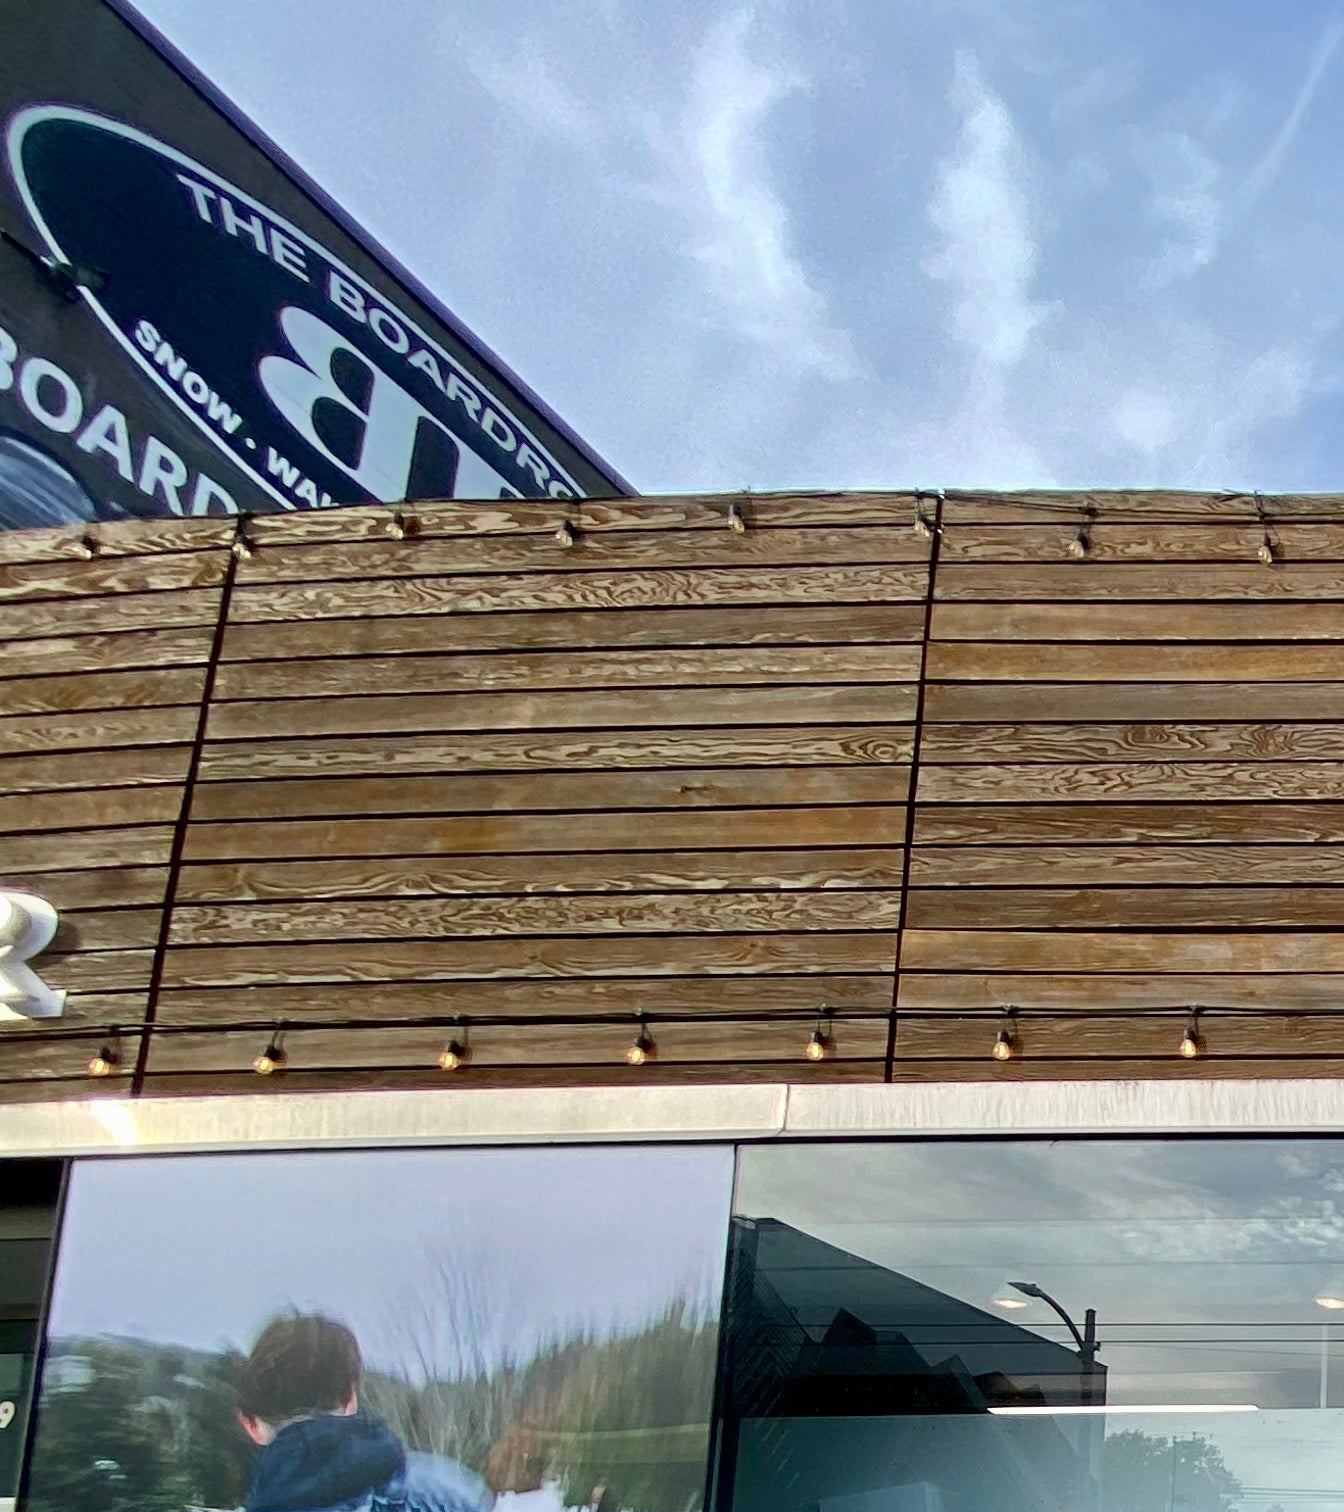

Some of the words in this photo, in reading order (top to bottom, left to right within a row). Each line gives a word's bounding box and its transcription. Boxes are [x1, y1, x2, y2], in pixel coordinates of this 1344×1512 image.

[135, 319, 243, 434] SNOW
[267, 446, 338, 509] WA
[177, 174, 310, 283] THE
[328, 269, 577, 499] BOARDR
